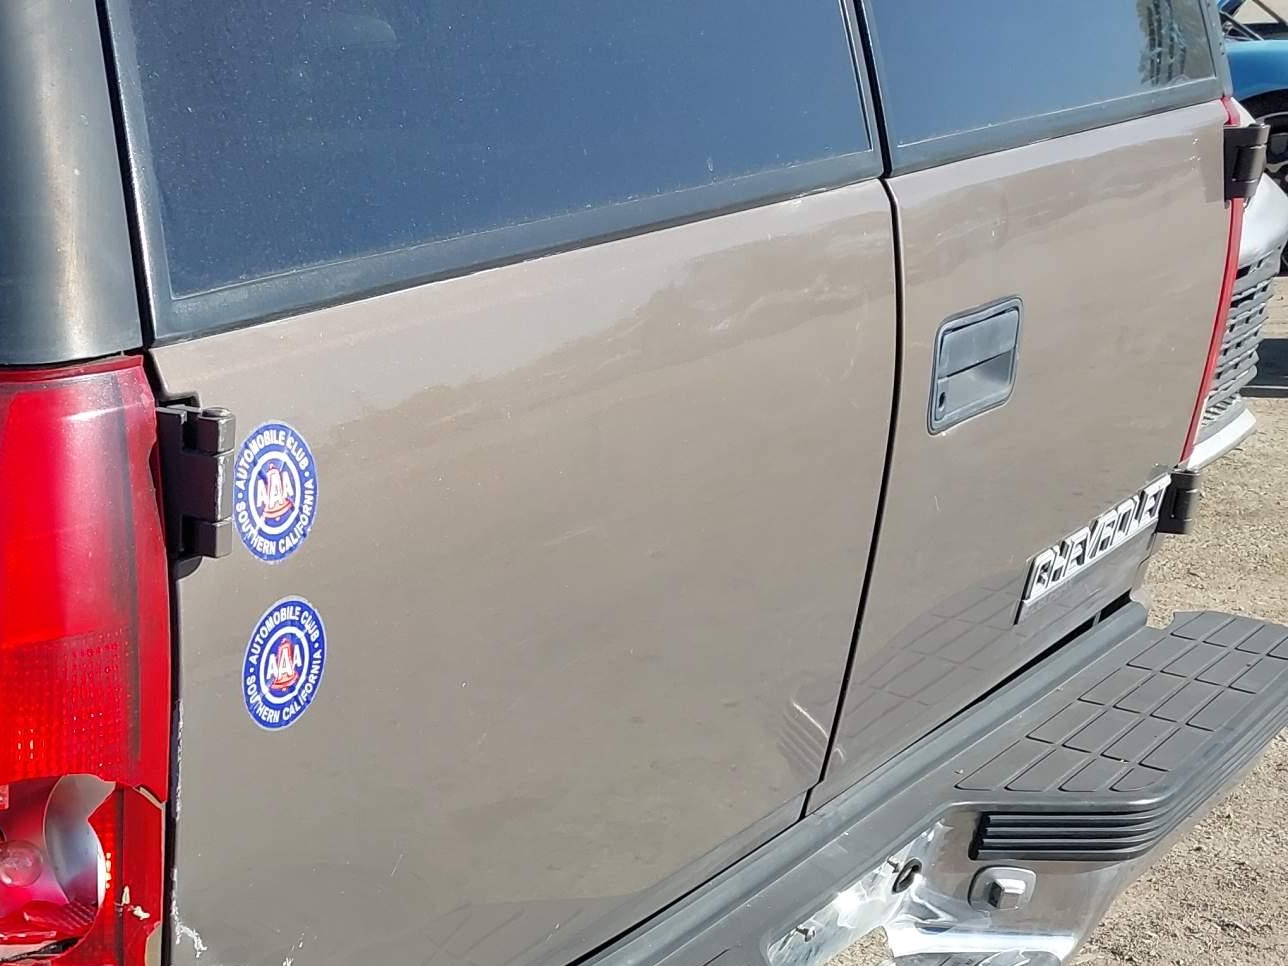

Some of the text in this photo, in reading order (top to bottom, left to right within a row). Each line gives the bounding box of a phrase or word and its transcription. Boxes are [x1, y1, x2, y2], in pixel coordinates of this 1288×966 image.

[235, 429, 310, 491] AUTOMOBILE CLUB
[256, 469, 295, 509] AAA
[235, 478, 315, 555] SOUTHERN CALIFORNIA
[248, 605, 320, 665] AUTOMOBILE CLUB
[266, 644, 303, 681] AAA
[246, 648, 323, 724] SOUTHERN CALIFORNIA
